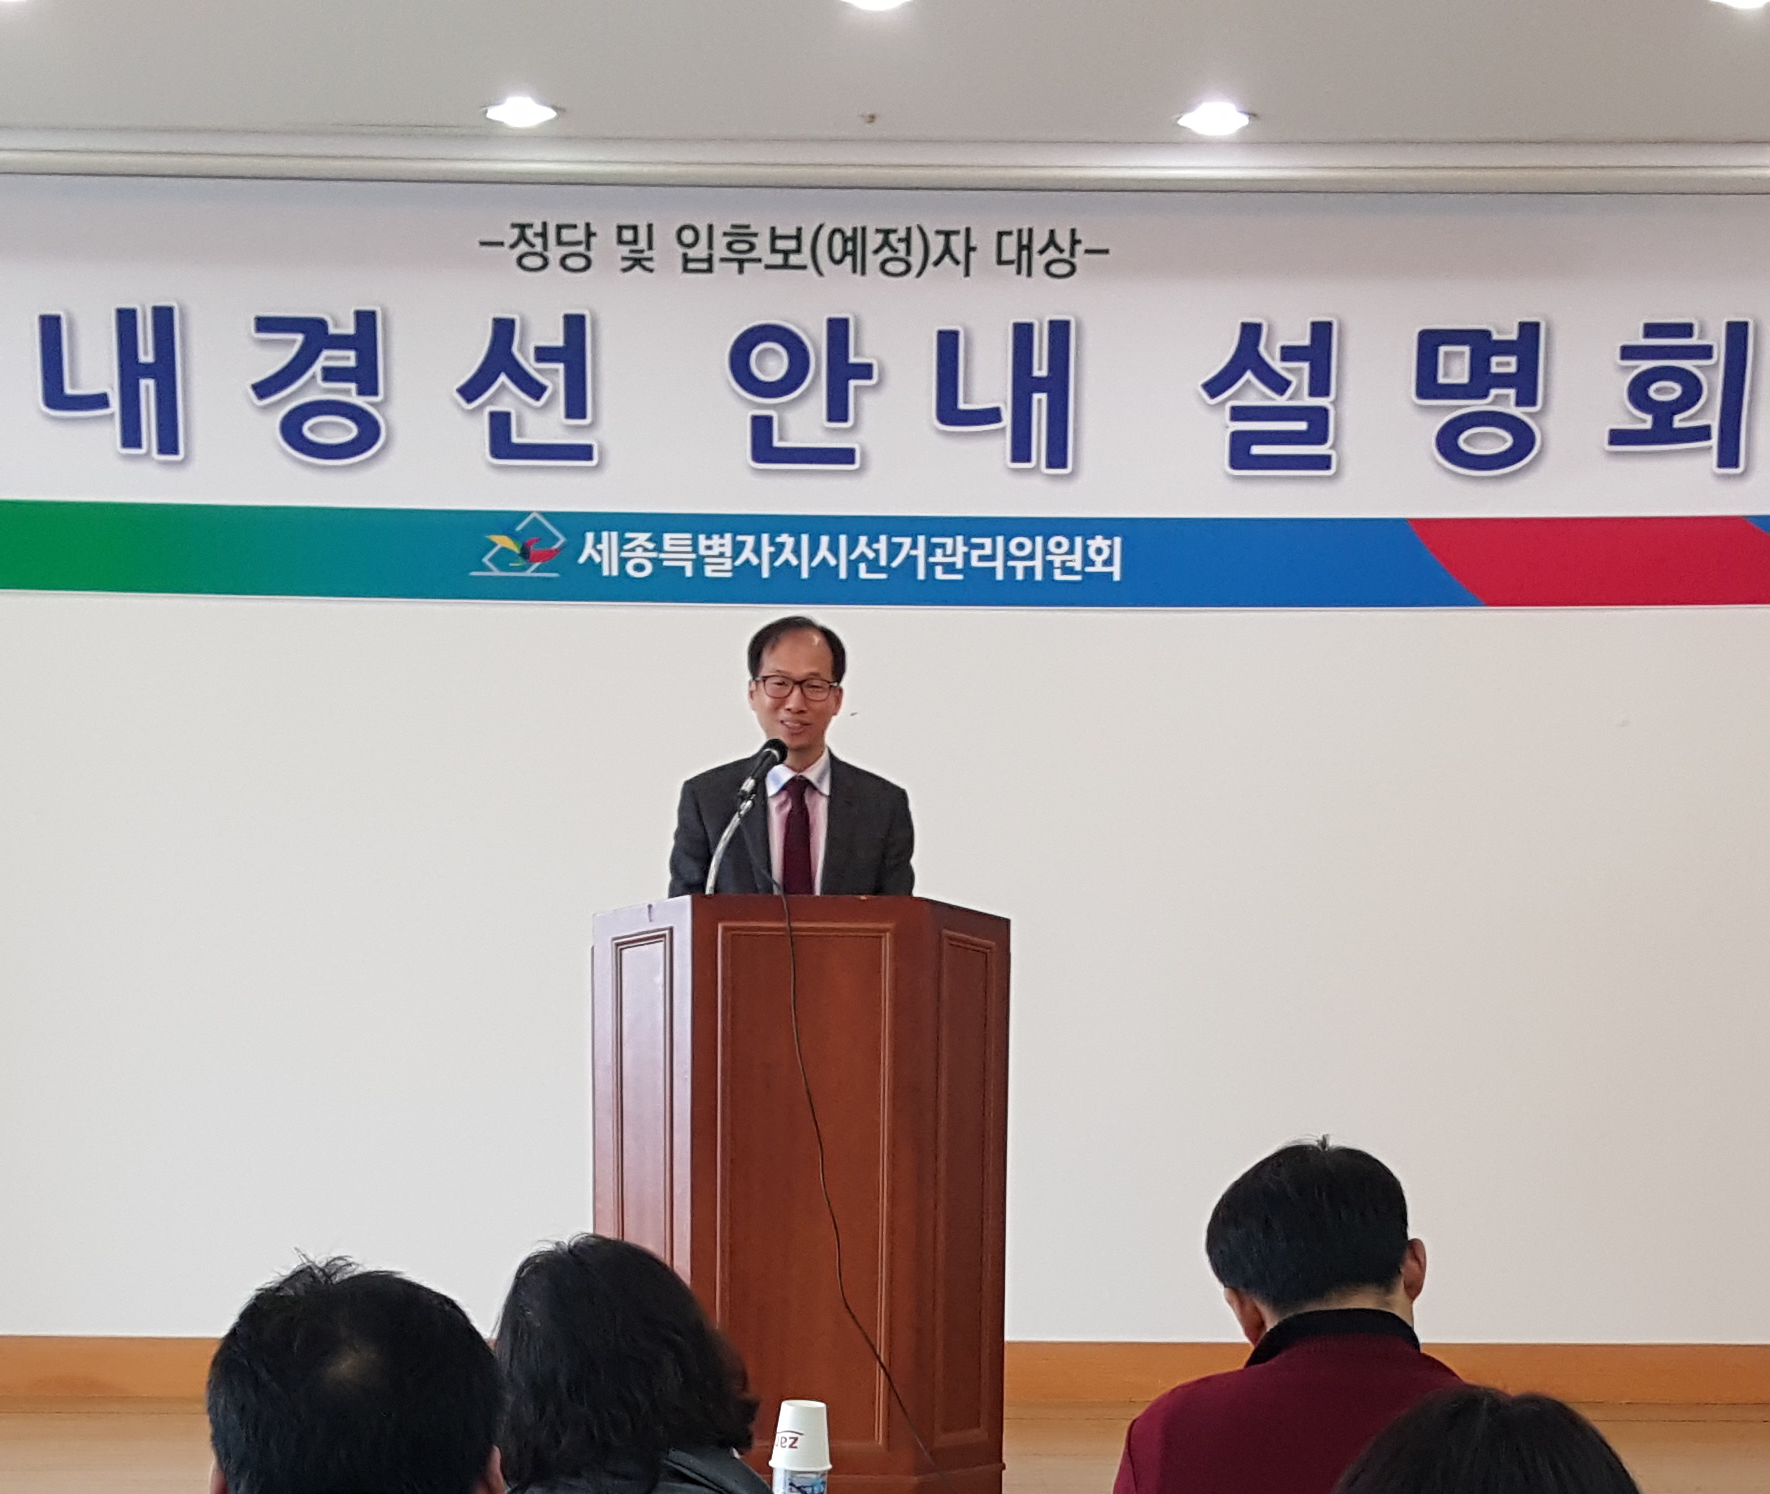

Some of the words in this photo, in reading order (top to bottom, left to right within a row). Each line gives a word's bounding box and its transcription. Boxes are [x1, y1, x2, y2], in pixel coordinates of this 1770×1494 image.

[616, 222, 655, 274] 및
[675, 223, 978, 279] 입후보(예정)자
[728, 316, 1072, 470] 안내
[1201, 320, 1750, 472] 설명회
[577, 529, 1124, 582] 세종특별자치시선거관리위원회
